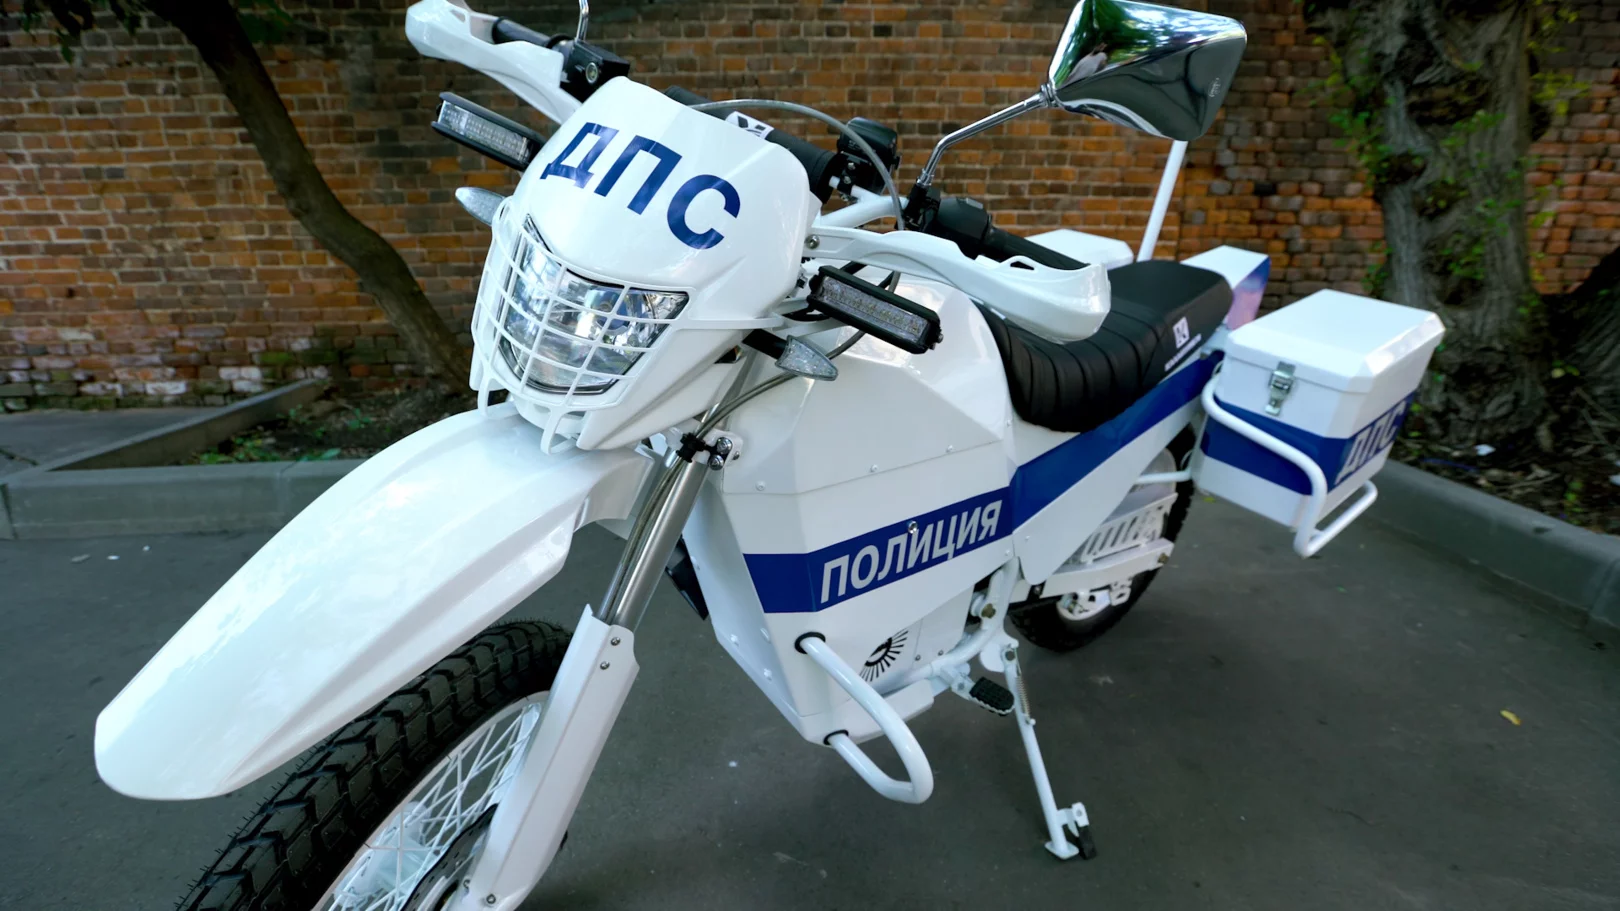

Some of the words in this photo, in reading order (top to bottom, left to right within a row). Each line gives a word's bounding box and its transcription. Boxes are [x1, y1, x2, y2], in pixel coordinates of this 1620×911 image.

[539, 121, 741, 250] ДПС
[1334, 400, 1407, 486] ДПС
[820, 499, 1003, 605] ПОЛИЦИЯ
